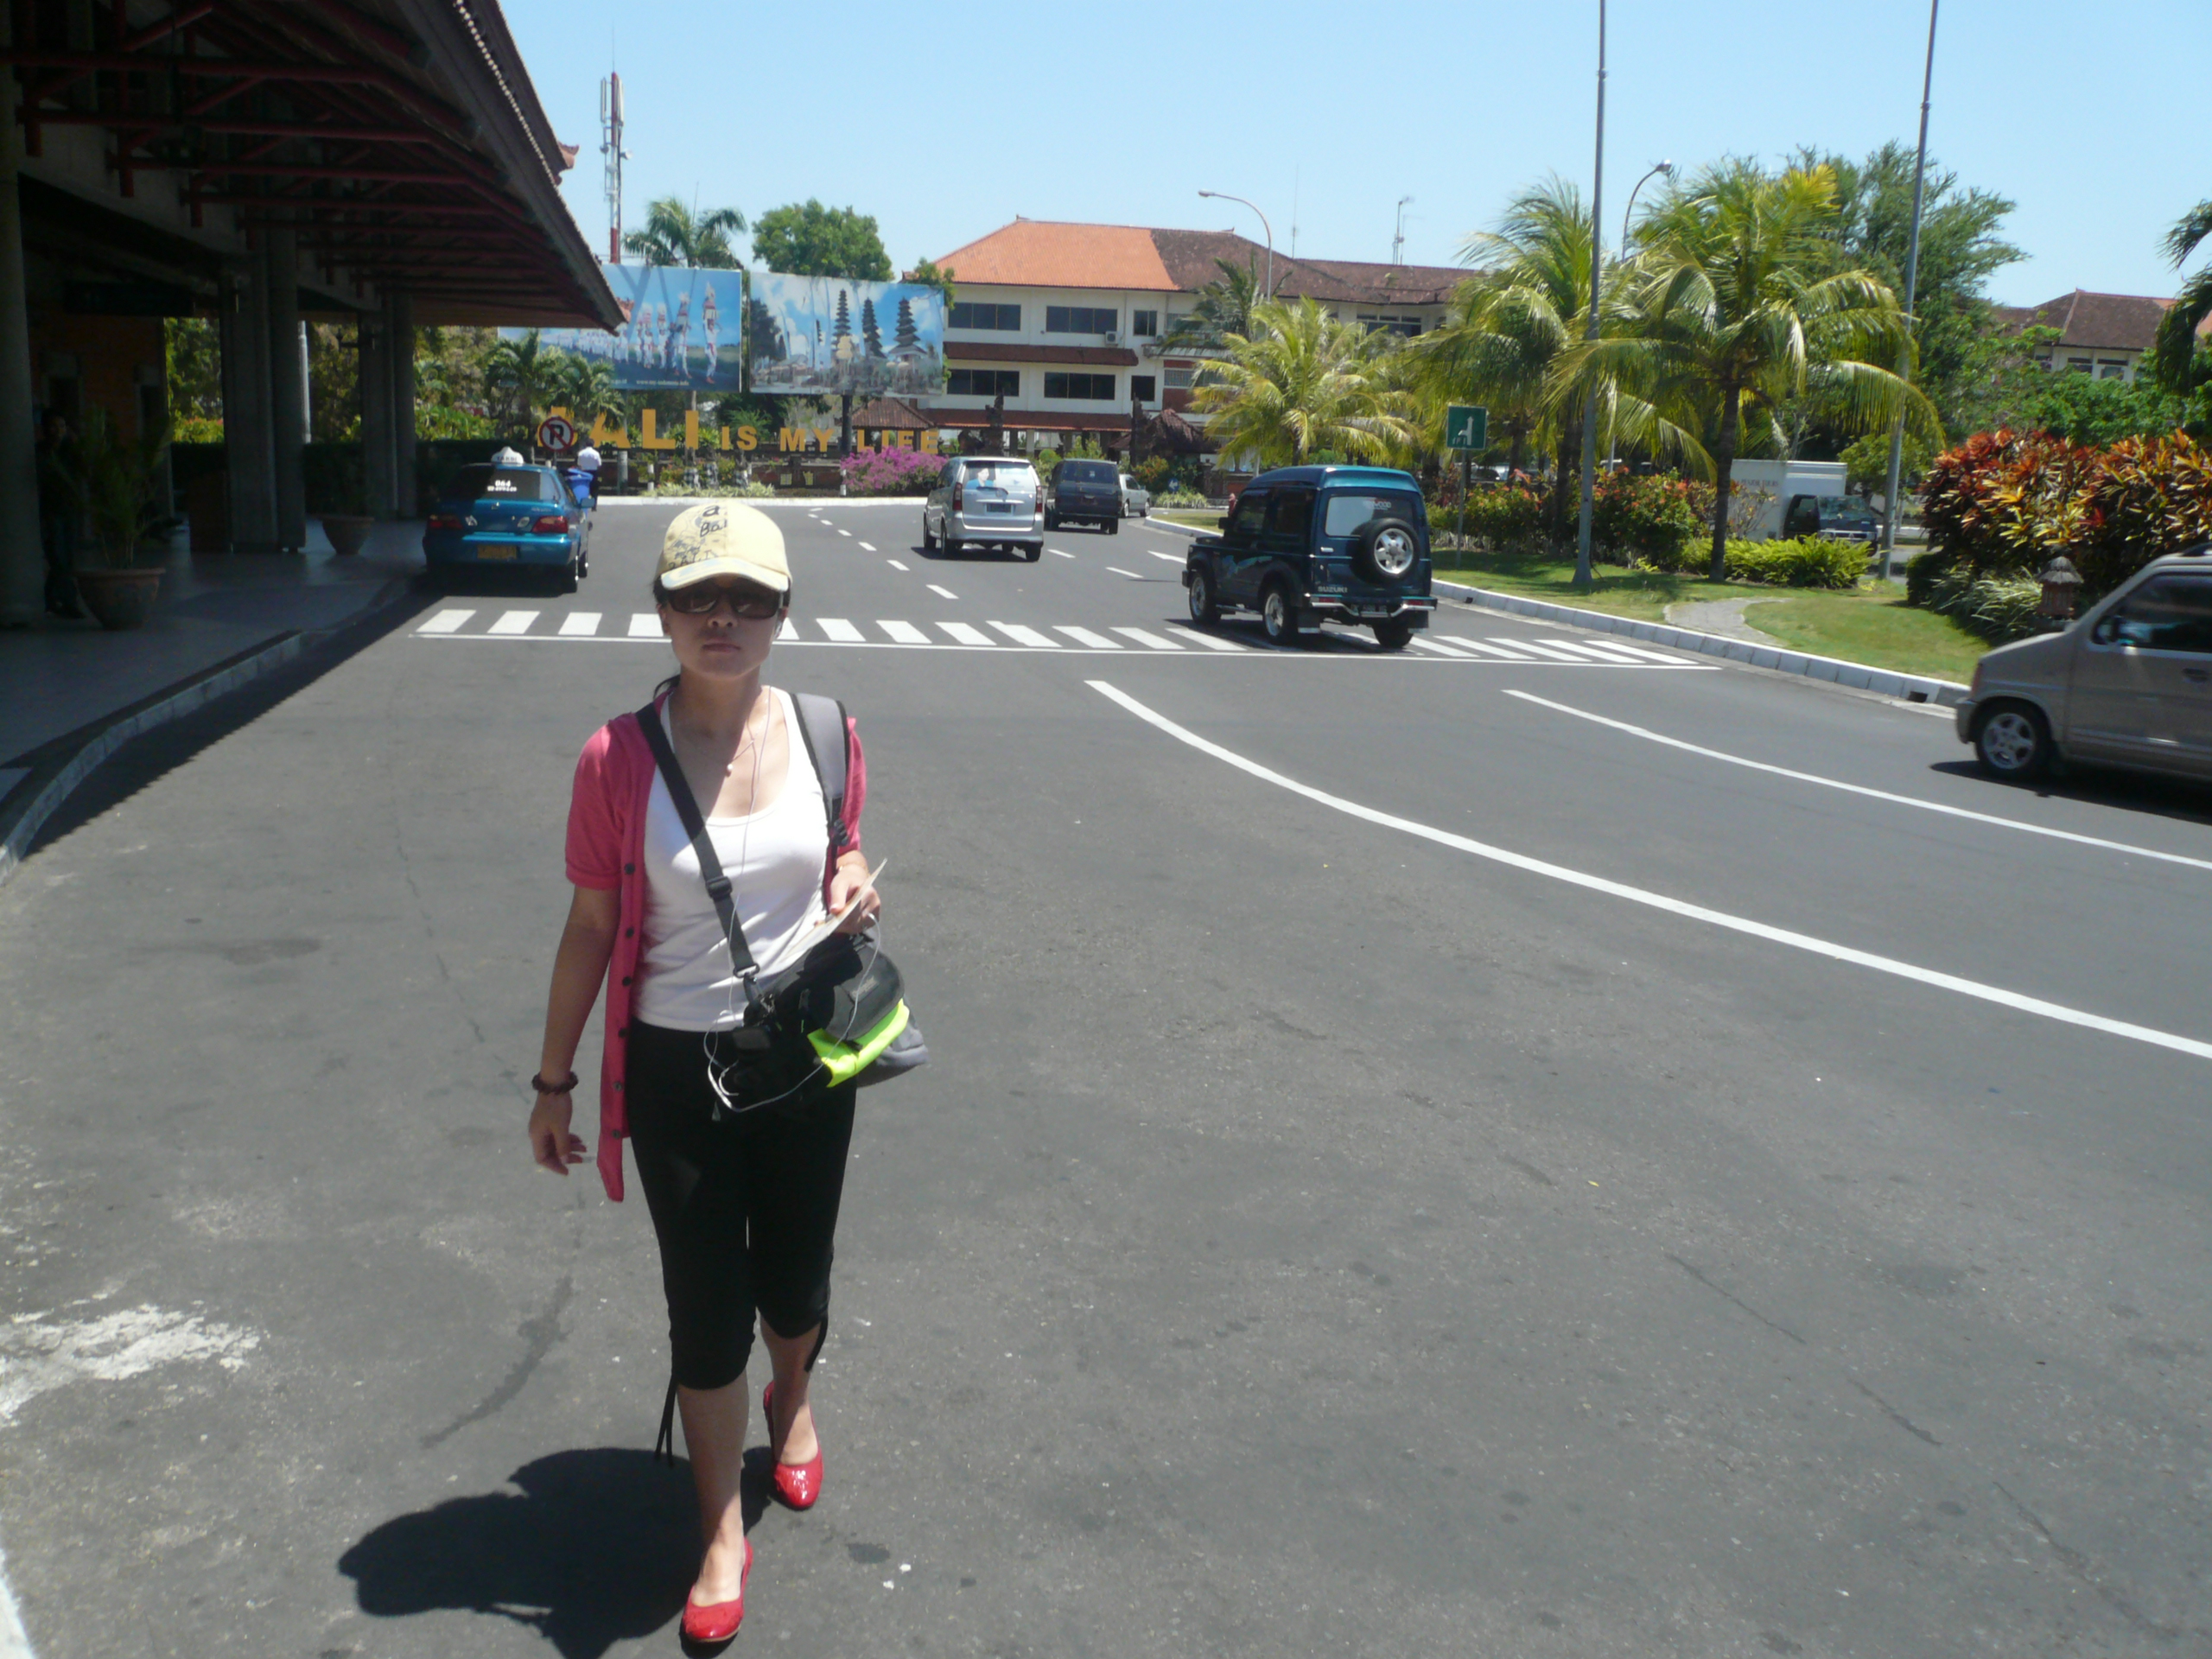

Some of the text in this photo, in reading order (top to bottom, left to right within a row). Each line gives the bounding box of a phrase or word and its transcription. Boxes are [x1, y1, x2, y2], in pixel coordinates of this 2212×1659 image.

[721, 425, 758, 451] IS
[779, 427, 835, 452] MY
[856, 427, 939, 454] LIFE
